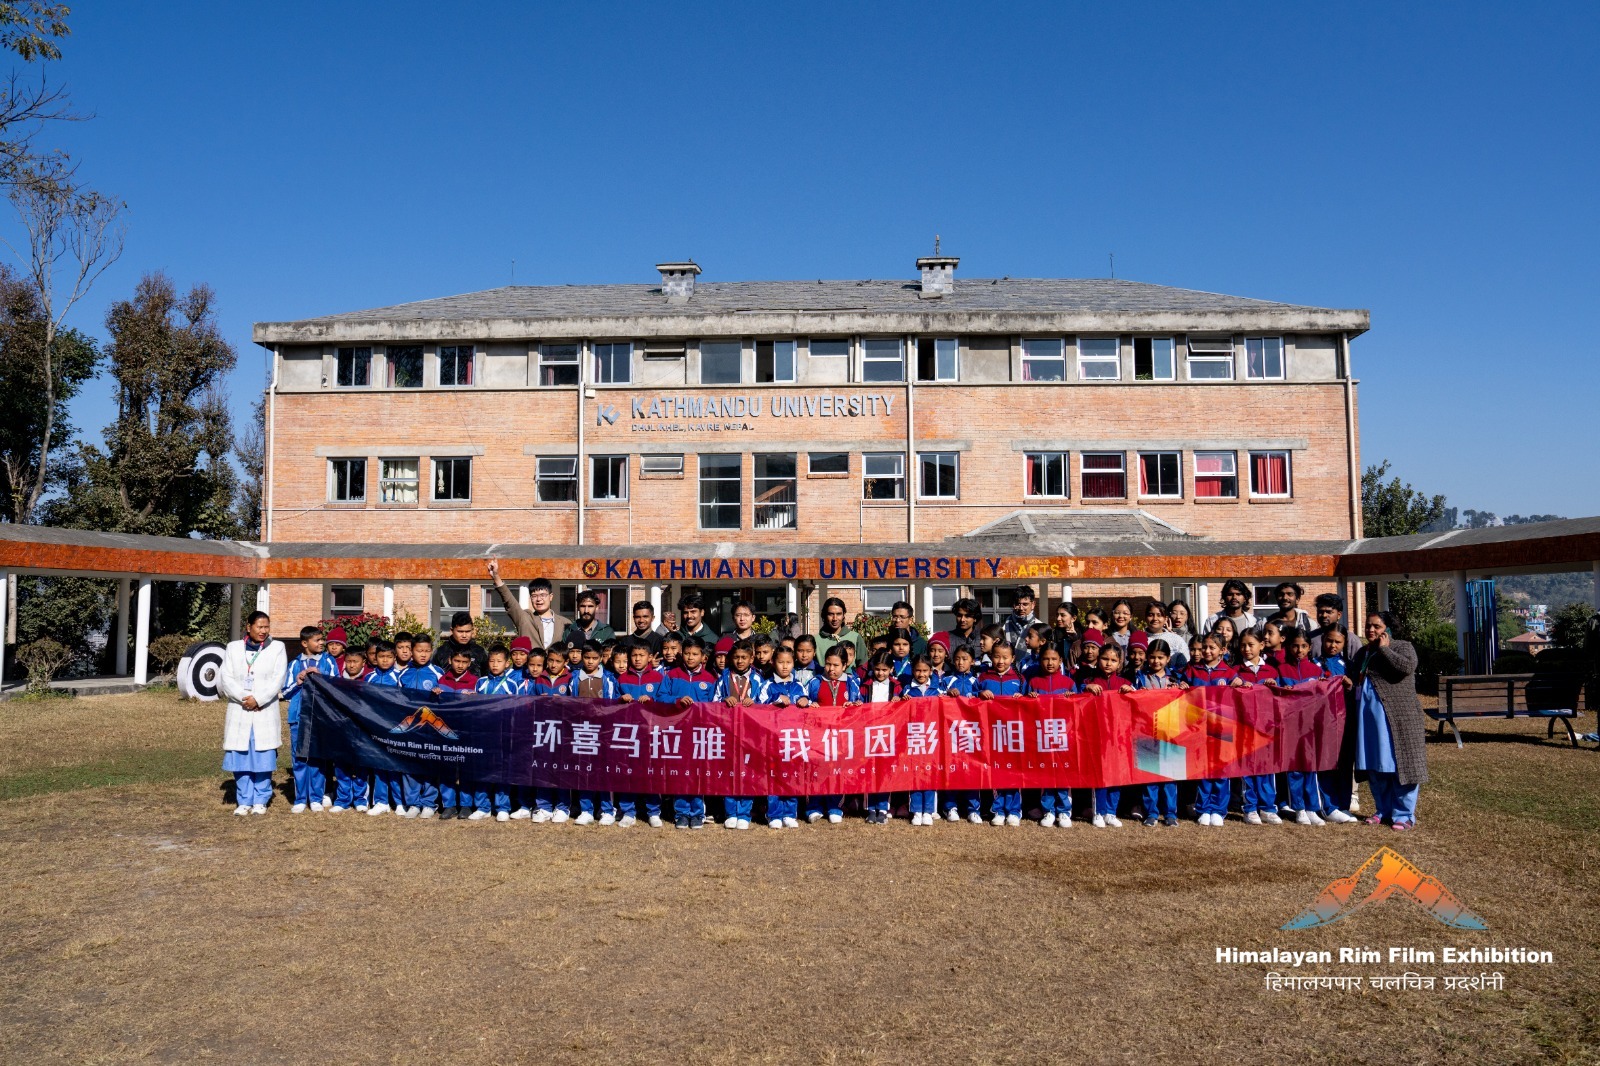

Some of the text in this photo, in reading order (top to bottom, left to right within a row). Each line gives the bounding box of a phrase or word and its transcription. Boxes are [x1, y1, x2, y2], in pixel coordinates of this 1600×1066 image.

[631, 394, 896, 419] KATHMANDU UNIVERSITY
[605, 557, 1002, 578] KATHMANDU UNIVERSITY
[1017, 564, 1060, 577] ARTS
[407, 741, 423, 750] Rim
[423, 743, 441, 751] Film
[442, 744, 484, 754] Exhibition
[532, 760, 1070, 778] Around the Himalayas, Let's Meet Through the Lens
